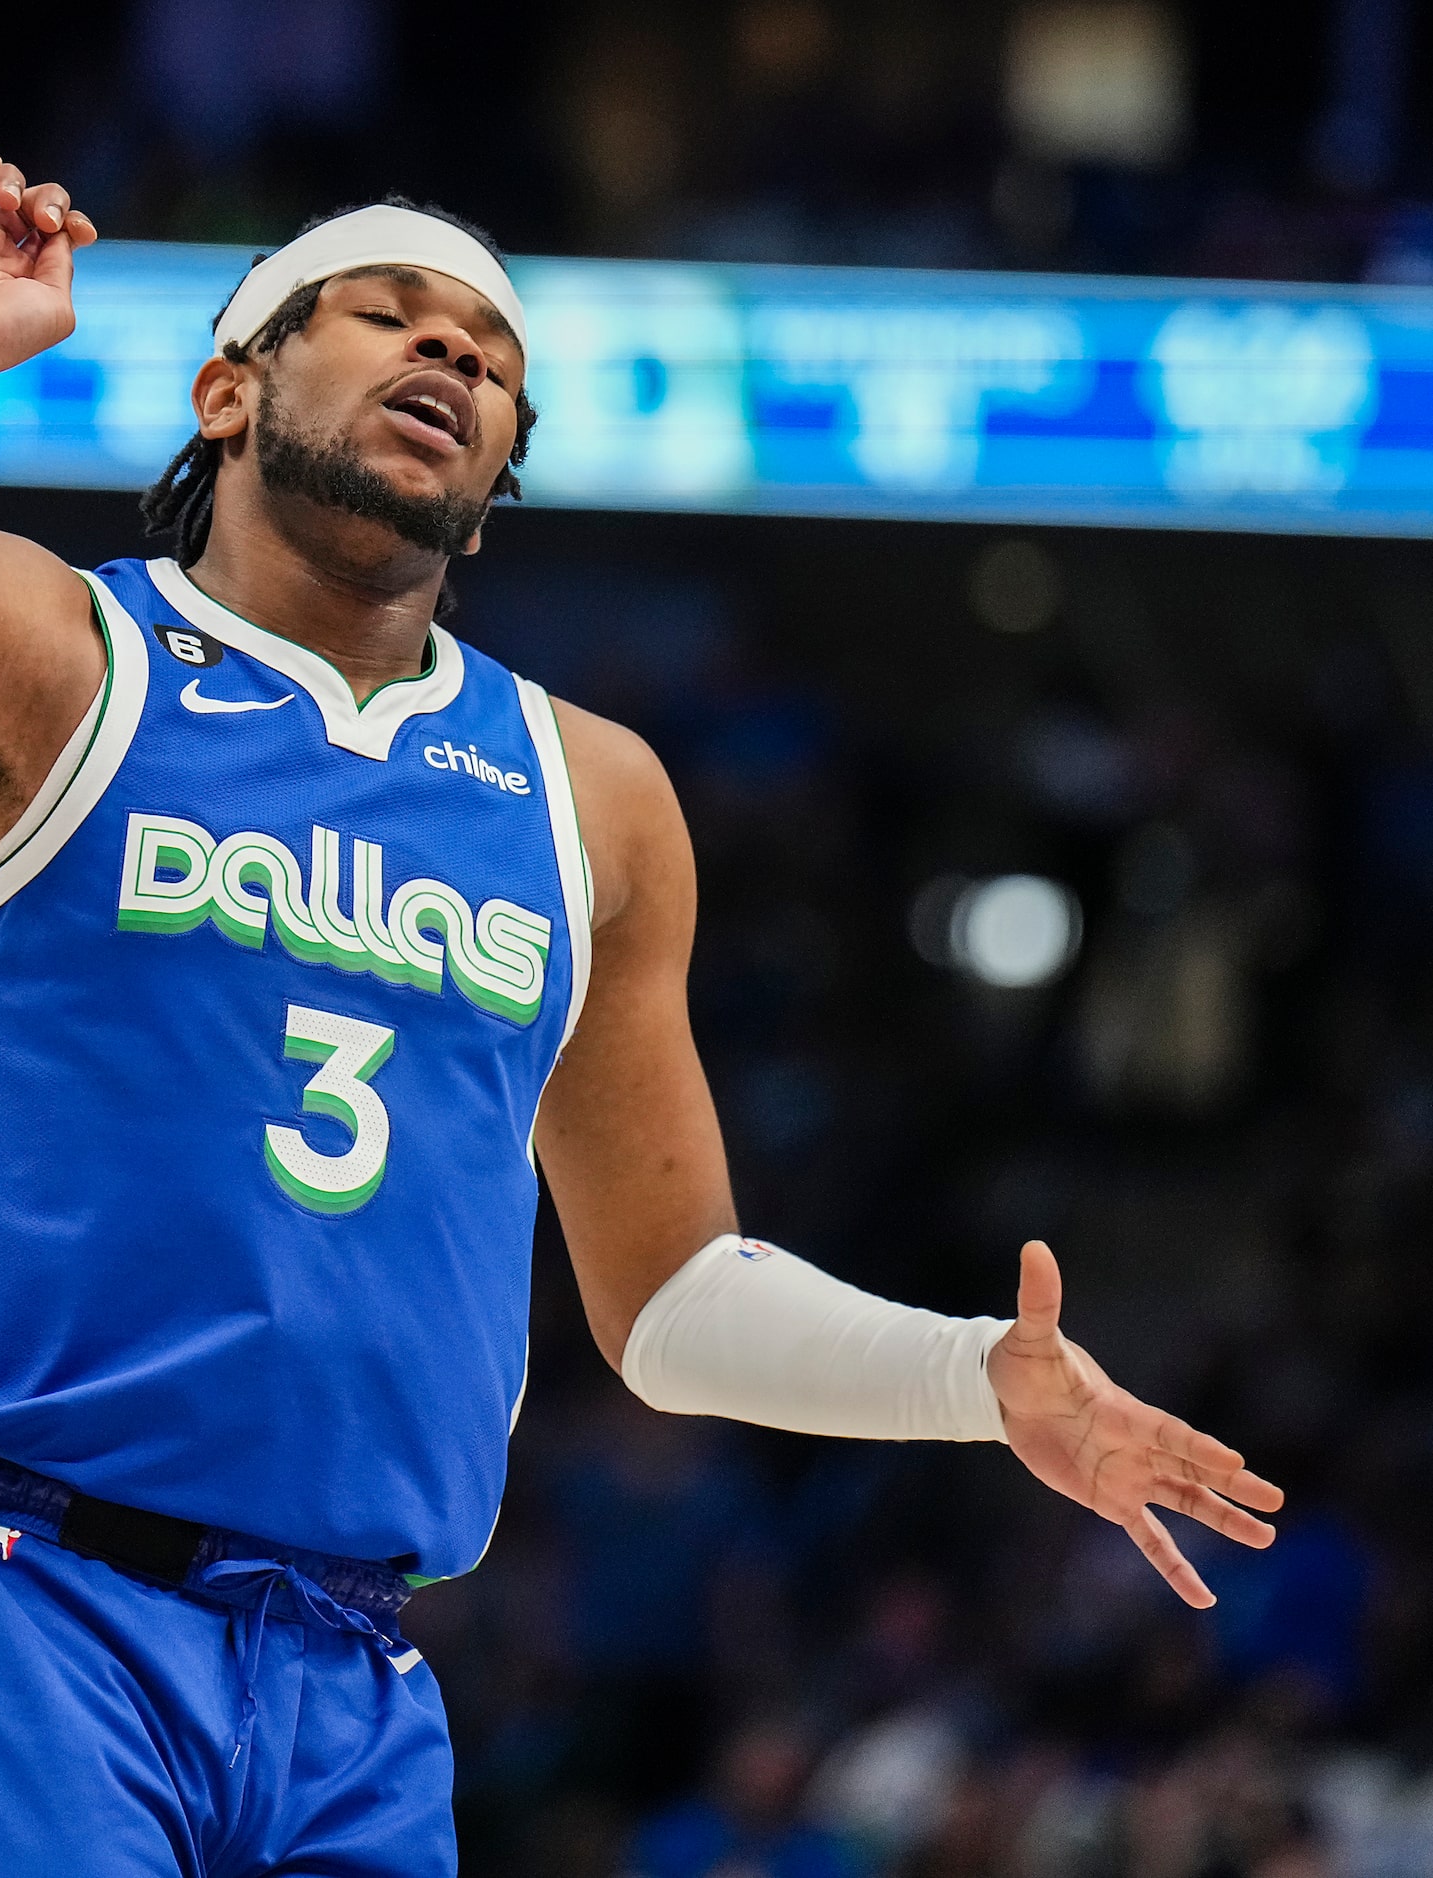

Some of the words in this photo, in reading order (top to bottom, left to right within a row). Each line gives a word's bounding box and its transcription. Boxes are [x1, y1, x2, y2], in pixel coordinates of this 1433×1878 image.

[165, 630, 206, 664] 6
[423, 740, 531, 795] chime
[117, 812, 552, 1026] Dallas
[264, 1003, 395, 1214] 3
